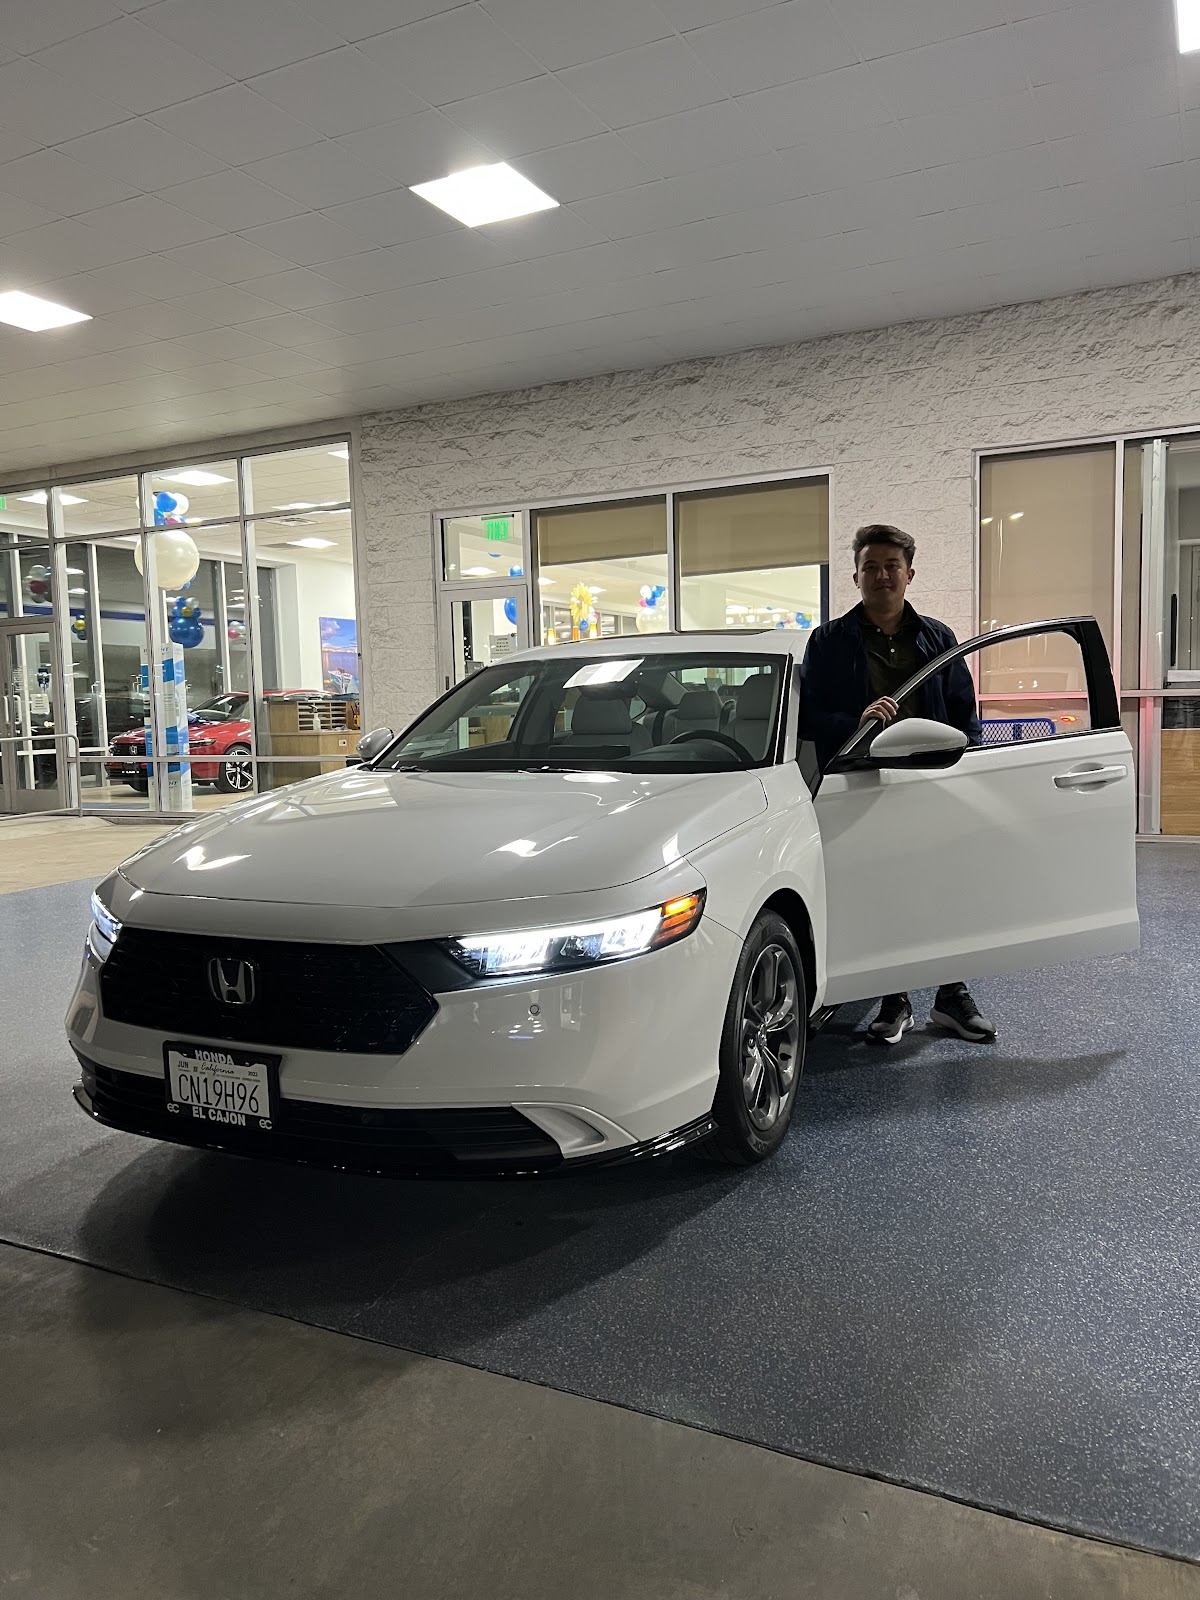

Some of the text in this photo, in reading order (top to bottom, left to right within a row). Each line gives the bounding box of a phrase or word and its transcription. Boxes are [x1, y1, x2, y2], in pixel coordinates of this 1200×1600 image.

[178, 1060, 189, 1069] JUN
[195, 1050, 235, 1066] HONDA
[201, 1062, 235, 1076] California
[178, 1074, 259, 1113] CN19H96
[192, 1105, 246, 1126] EL CAJON
